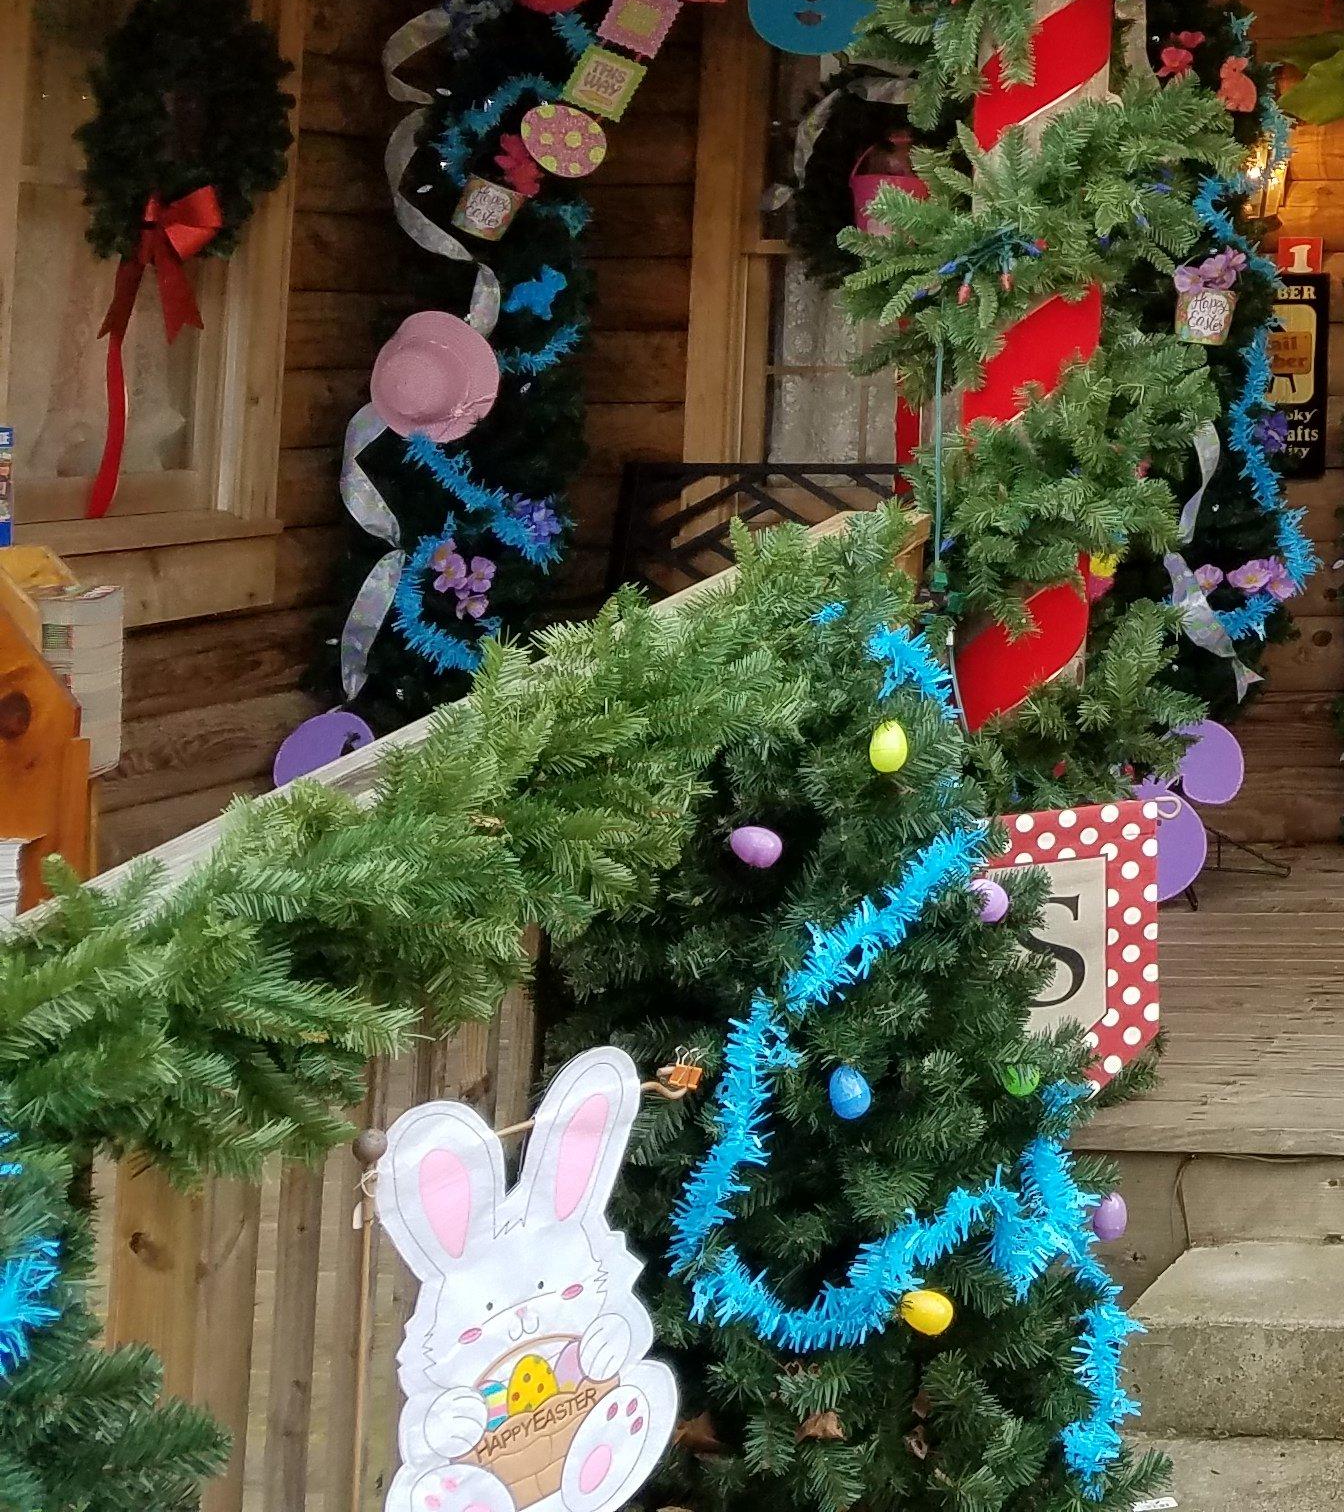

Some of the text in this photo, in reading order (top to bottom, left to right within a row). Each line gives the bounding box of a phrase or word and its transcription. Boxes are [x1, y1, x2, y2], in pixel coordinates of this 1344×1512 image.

[1286, 244, 1314, 273] 1
[1277, 285, 1317, 300] BER
[1273, 352, 1307, 369] ber
[1286, 426, 1319, 441] afts
[475, 1387, 597, 1464] HAPPY EASTER
